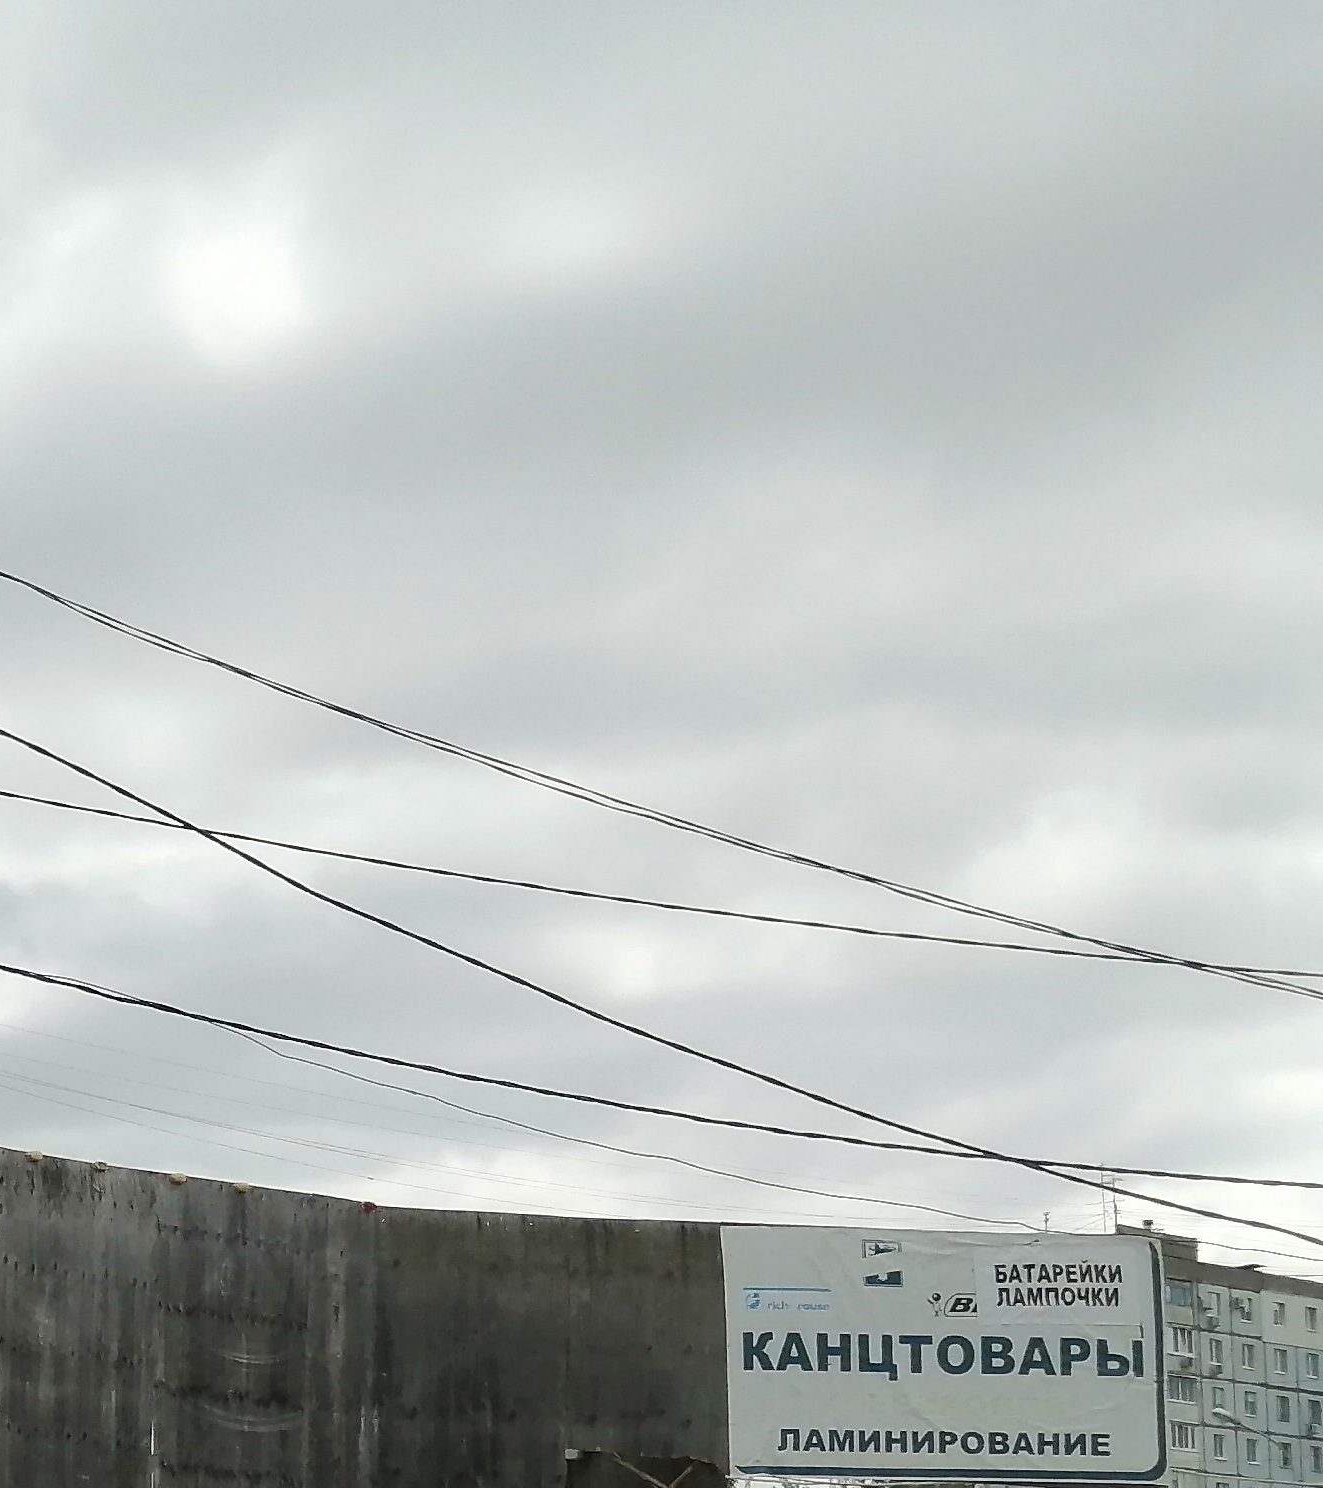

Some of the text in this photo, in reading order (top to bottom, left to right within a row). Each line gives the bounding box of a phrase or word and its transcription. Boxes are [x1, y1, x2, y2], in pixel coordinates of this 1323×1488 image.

[994, 1260, 1123, 1284] БАТАРЕЙКИ
[996, 1287, 1120, 1308] ЛАМПОЧКИ
[742, 1331, 1145, 1382] КАНЦТОВАРЫ
[777, 1428, 1111, 1458] ЛАМИНИРОВАНИЕ
